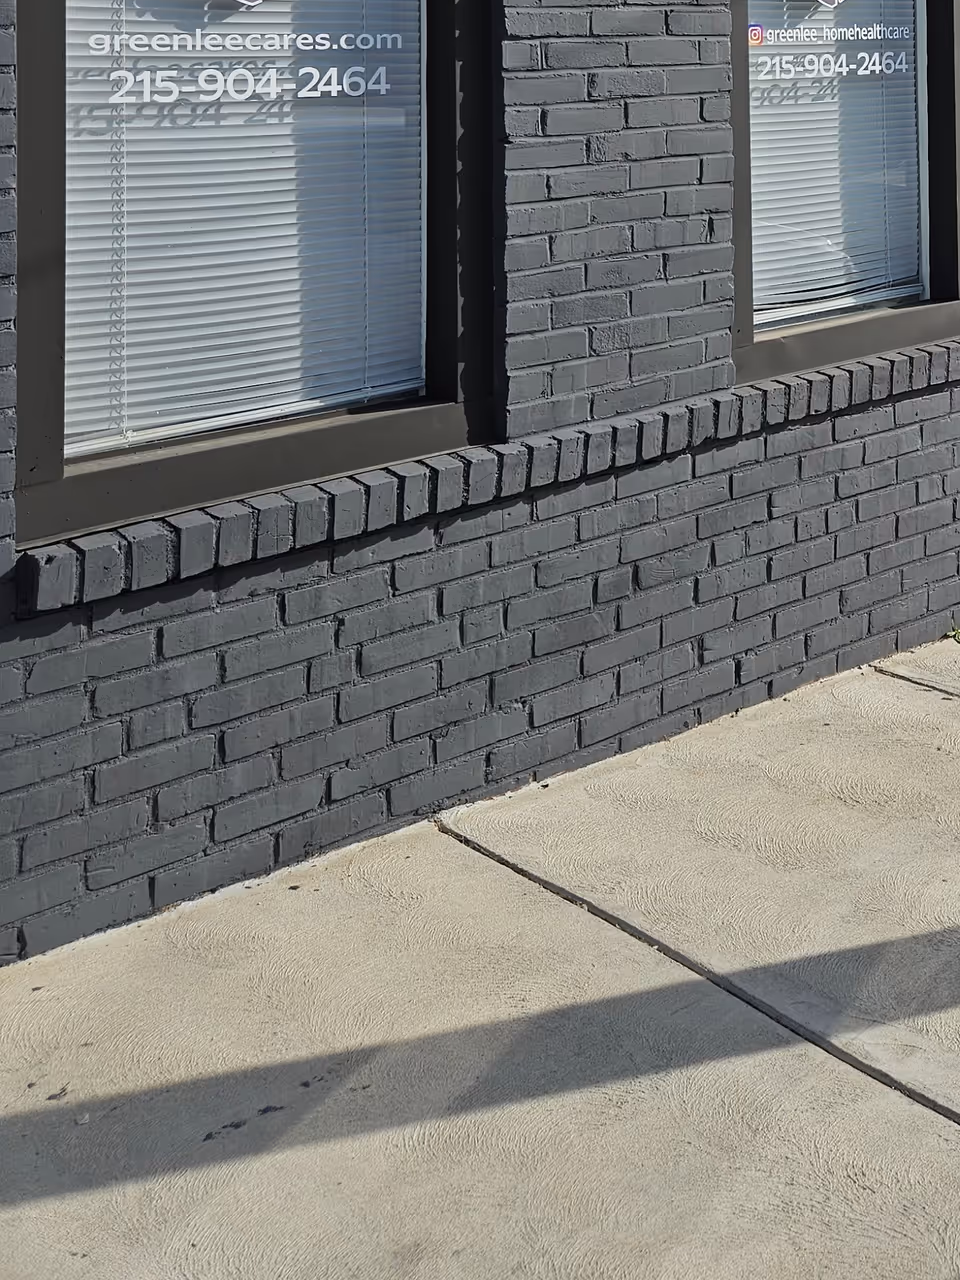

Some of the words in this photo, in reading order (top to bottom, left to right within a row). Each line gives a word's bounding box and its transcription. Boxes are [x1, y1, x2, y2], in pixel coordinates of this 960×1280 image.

[88, 29, 402, 55] greenleecares.com
[766, 23, 910, 44] greenlee_homehealthcare
[757, 51, 908, 80] 215-904-2464
[108, 66, 391, 103] 215-904-2464
